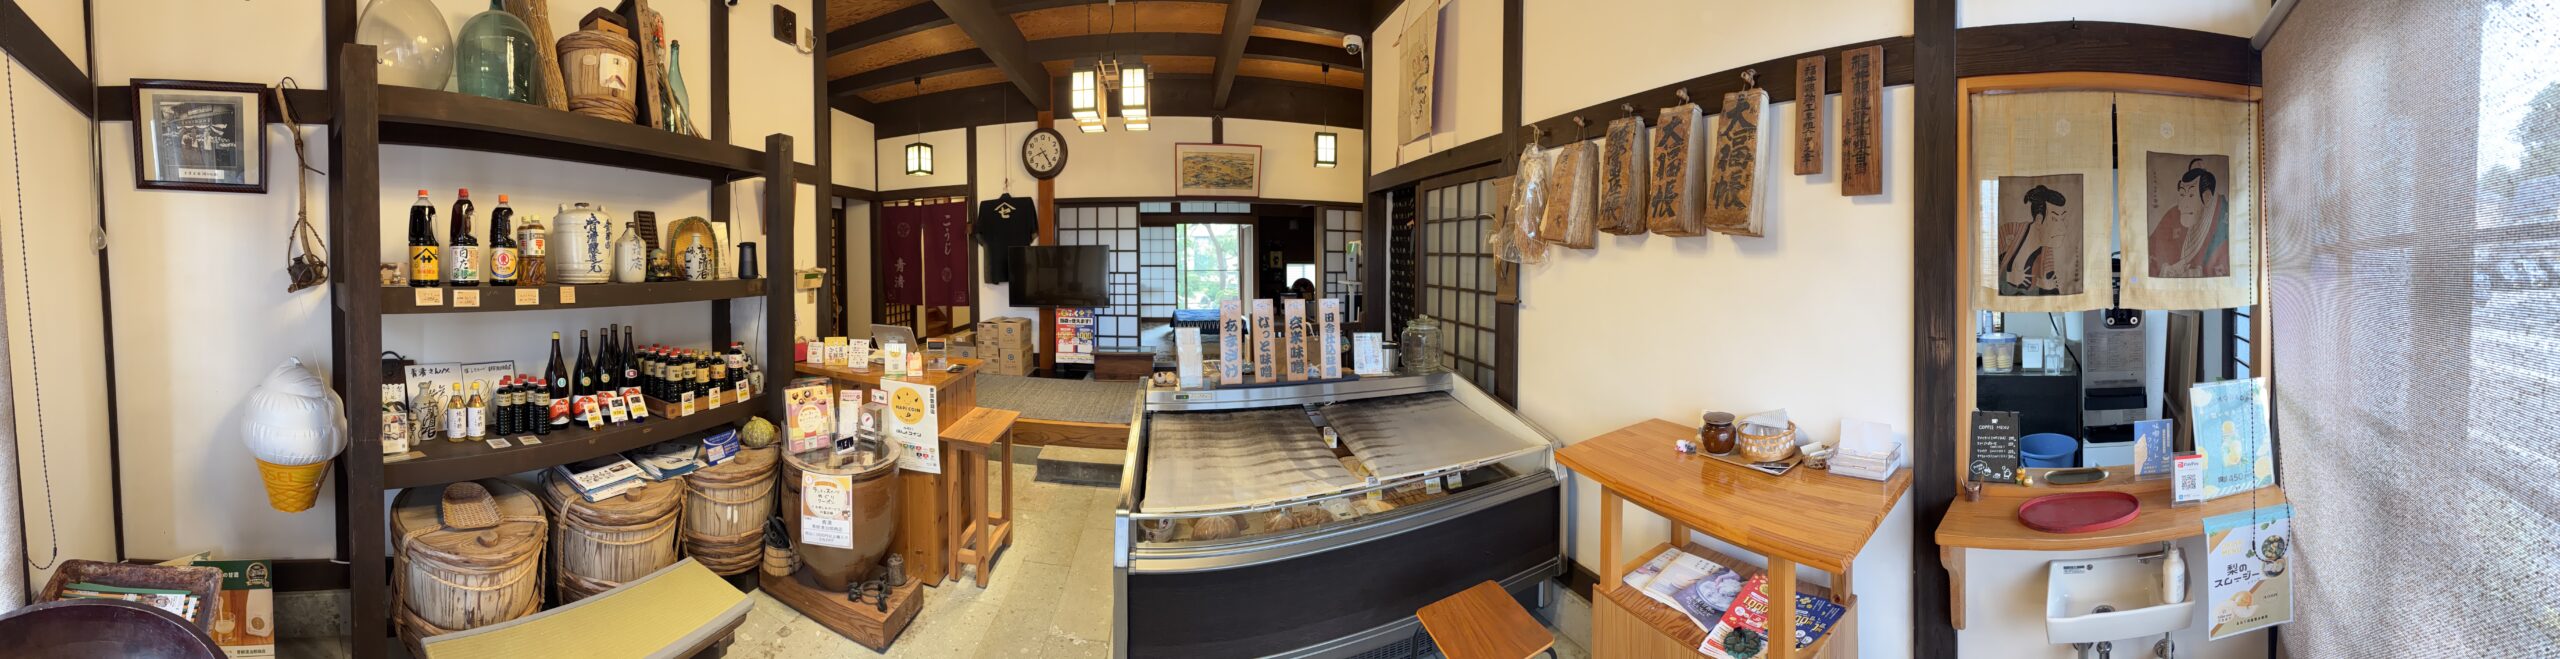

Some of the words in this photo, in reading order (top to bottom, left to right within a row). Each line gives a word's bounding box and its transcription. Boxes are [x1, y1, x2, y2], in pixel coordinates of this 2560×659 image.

[1652, 116, 1684, 217] 大福帳
[1711, 93, 1756, 209] 大福帳
[942, 214, 952, 255] こうじ
[2214, 570, 2260, 588] スムージー
[2226, 563, 2248, 576] 梨の
